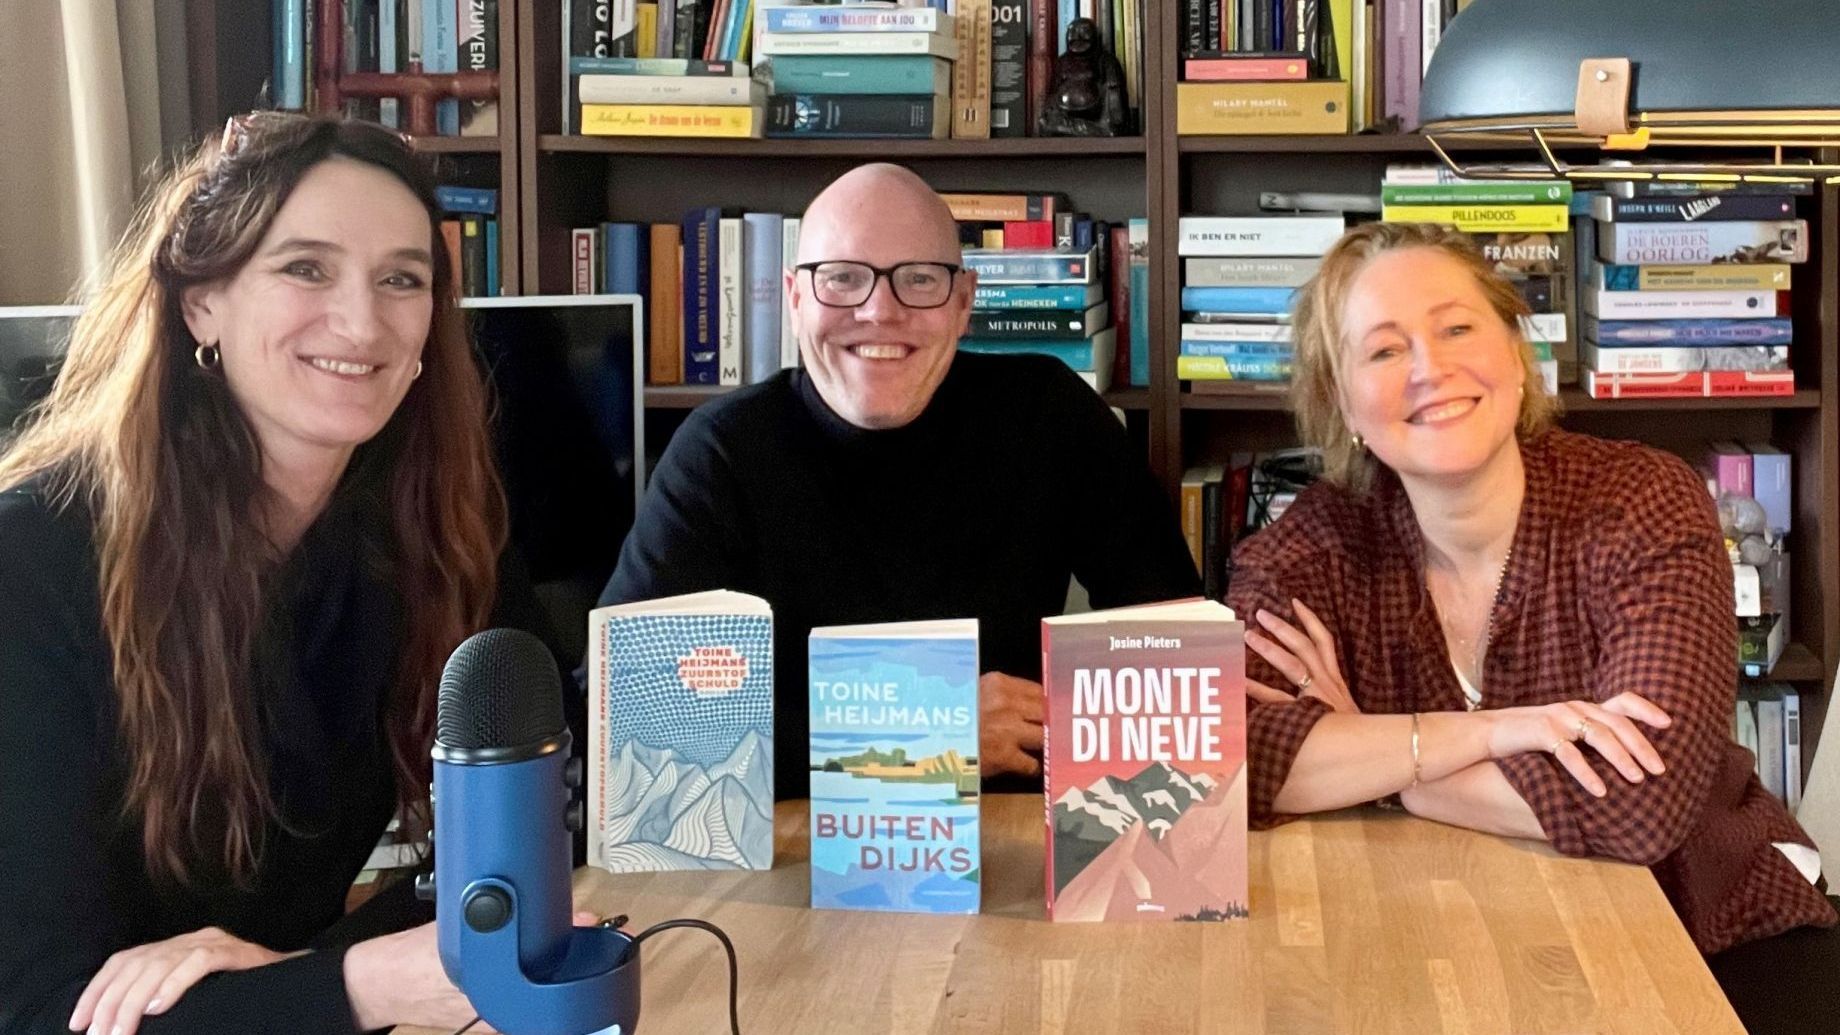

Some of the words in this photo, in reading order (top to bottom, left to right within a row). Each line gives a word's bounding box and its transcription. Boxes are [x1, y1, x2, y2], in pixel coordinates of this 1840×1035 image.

[1189, 233, 1199, 241] IK
[1201, 233, 1222, 241] BEN
[1224, 233, 1237, 241] ER
[1240, 233, 1262, 241] NIET
[1627, 235, 1647, 246] DE
[1484, 245, 1559, 260] FRANZEN
[1627, 247, 1709, 261] OORLOG
[1011, 299, 1058, 307] HEINEKEN
[988, 321, 1057, 331] METROPOLIS
[1109, 636, 1142, 650] Josine
[1144, 636, 1182, 649] Pieters
[695, 648, 732, 657] TOINE
[680, 658, 747, 667] HEIJMANS
[680, 669, 747, 678] ZUURSTOF
[688, 680, 738, 688] SCHULD
[1072, 667, 1221, 715] MONTE
[814, 682, 899, 702] TOINE
[825, 706, 971, 726] HEIJMANS
[1072, 717, 1110, 762] DI
[1121, 716, 1223, 762] NEVE
[816, 813, 954, 841] BUITEN
[860, 845, 971, 873] DIJKS
